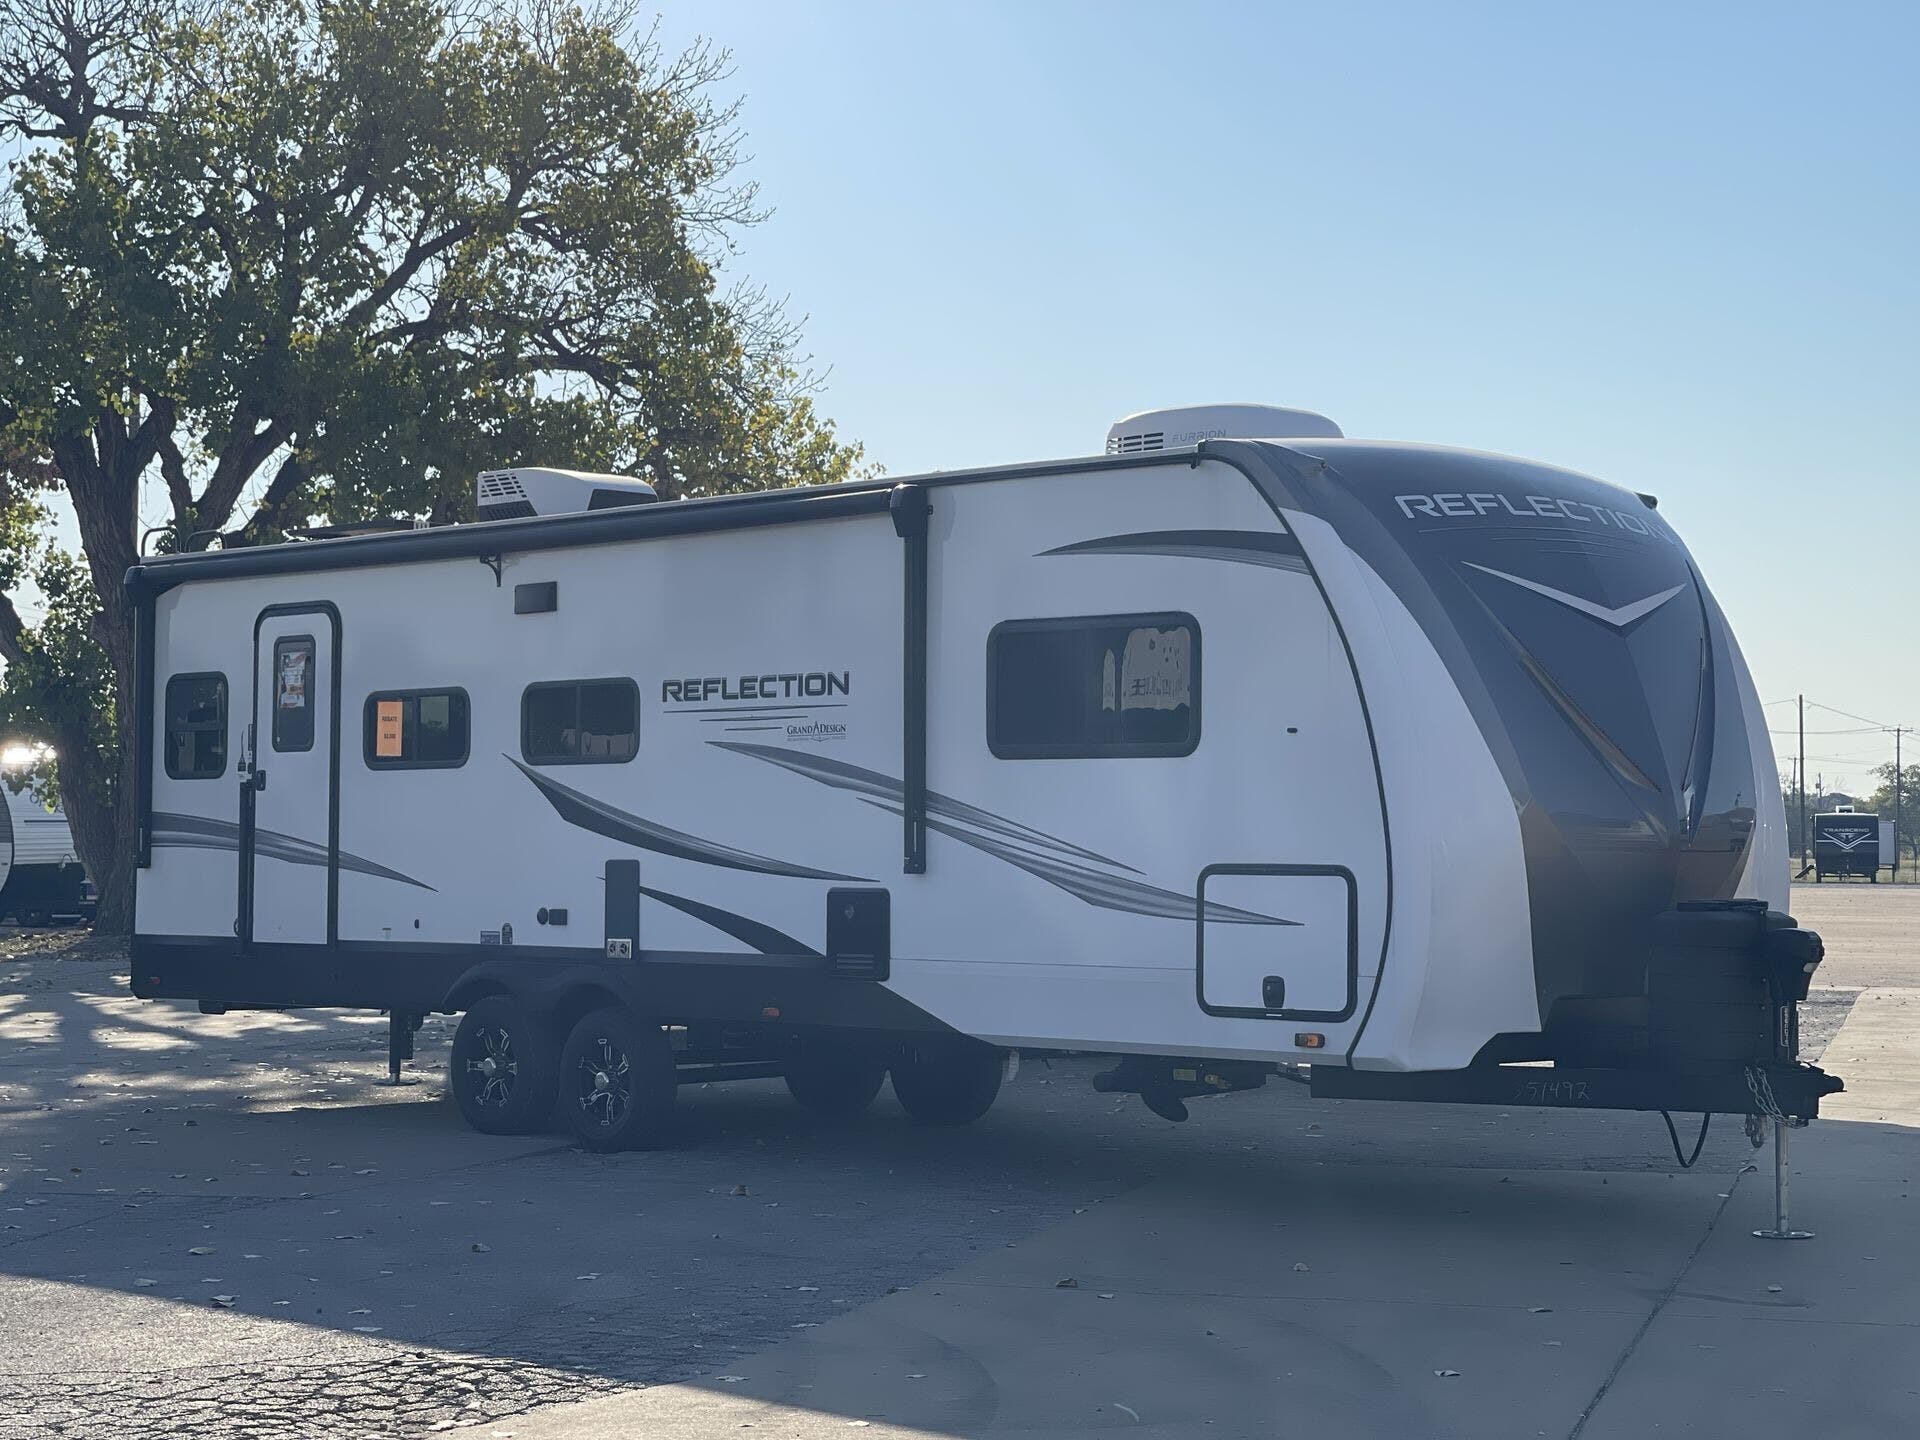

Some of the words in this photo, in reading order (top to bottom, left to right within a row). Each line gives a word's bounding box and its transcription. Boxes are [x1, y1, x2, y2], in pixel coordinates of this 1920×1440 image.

[1170, 429, 1227, 442] FURRION
[1394, 493, 1675, 545] REFLECTION
[662, 671, 849, 702] REFLECTION
[786, 724, 813, 735] GRAND
[819, 723, 846, 734] DESIGN
